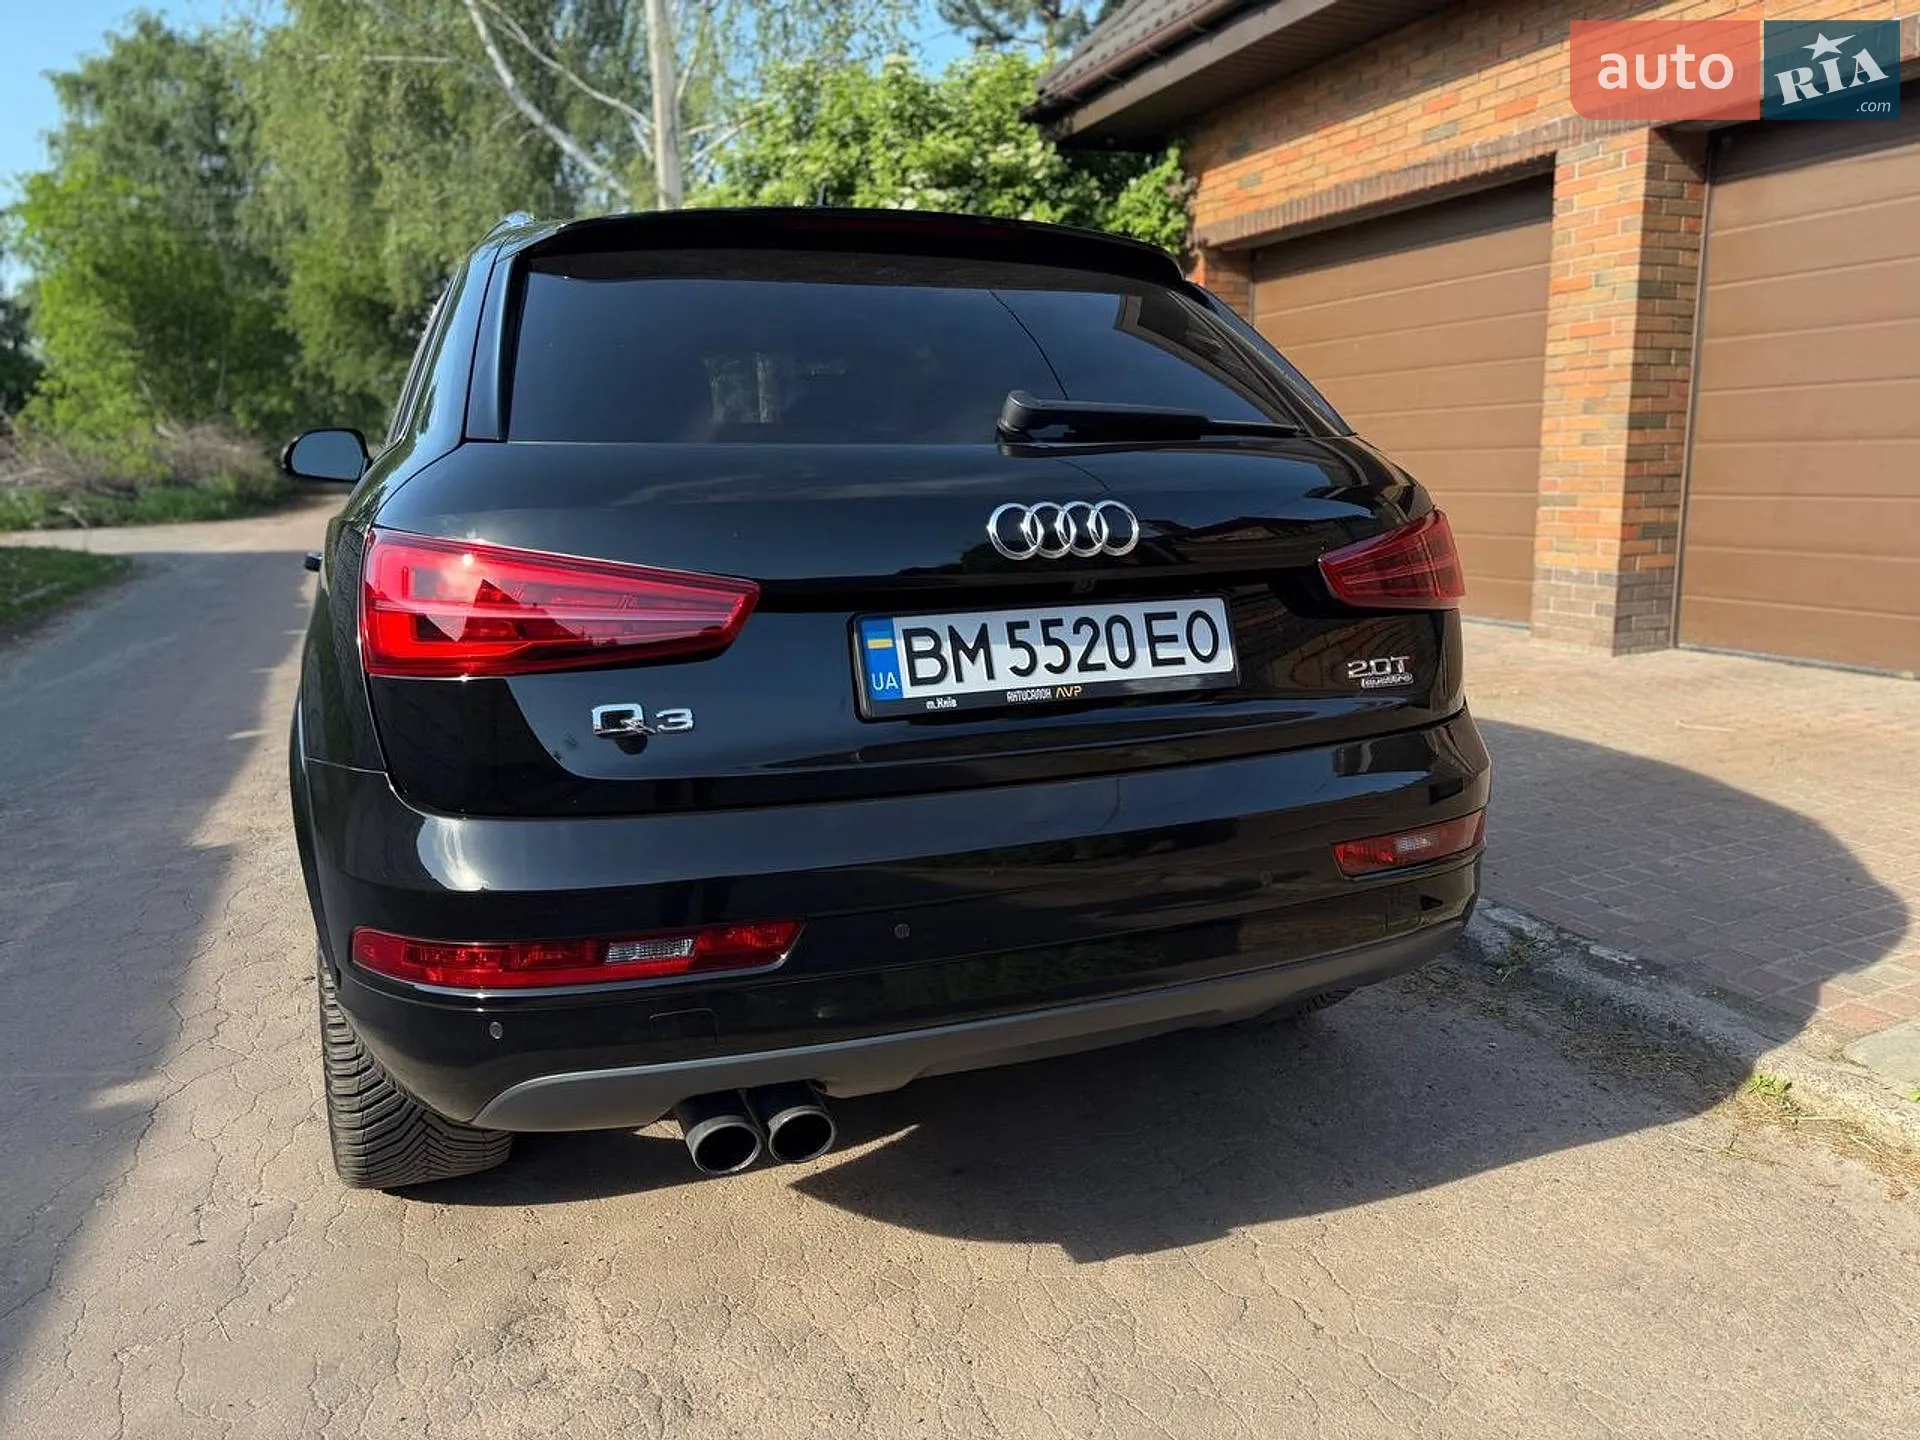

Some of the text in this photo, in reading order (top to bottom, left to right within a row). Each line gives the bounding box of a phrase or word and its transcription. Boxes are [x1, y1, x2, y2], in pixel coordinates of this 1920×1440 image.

[902, 610, 1219, 688] BM 5520 EO
[872, 672, 899, 691] UA
[592, 703, 694, 736] Q3
